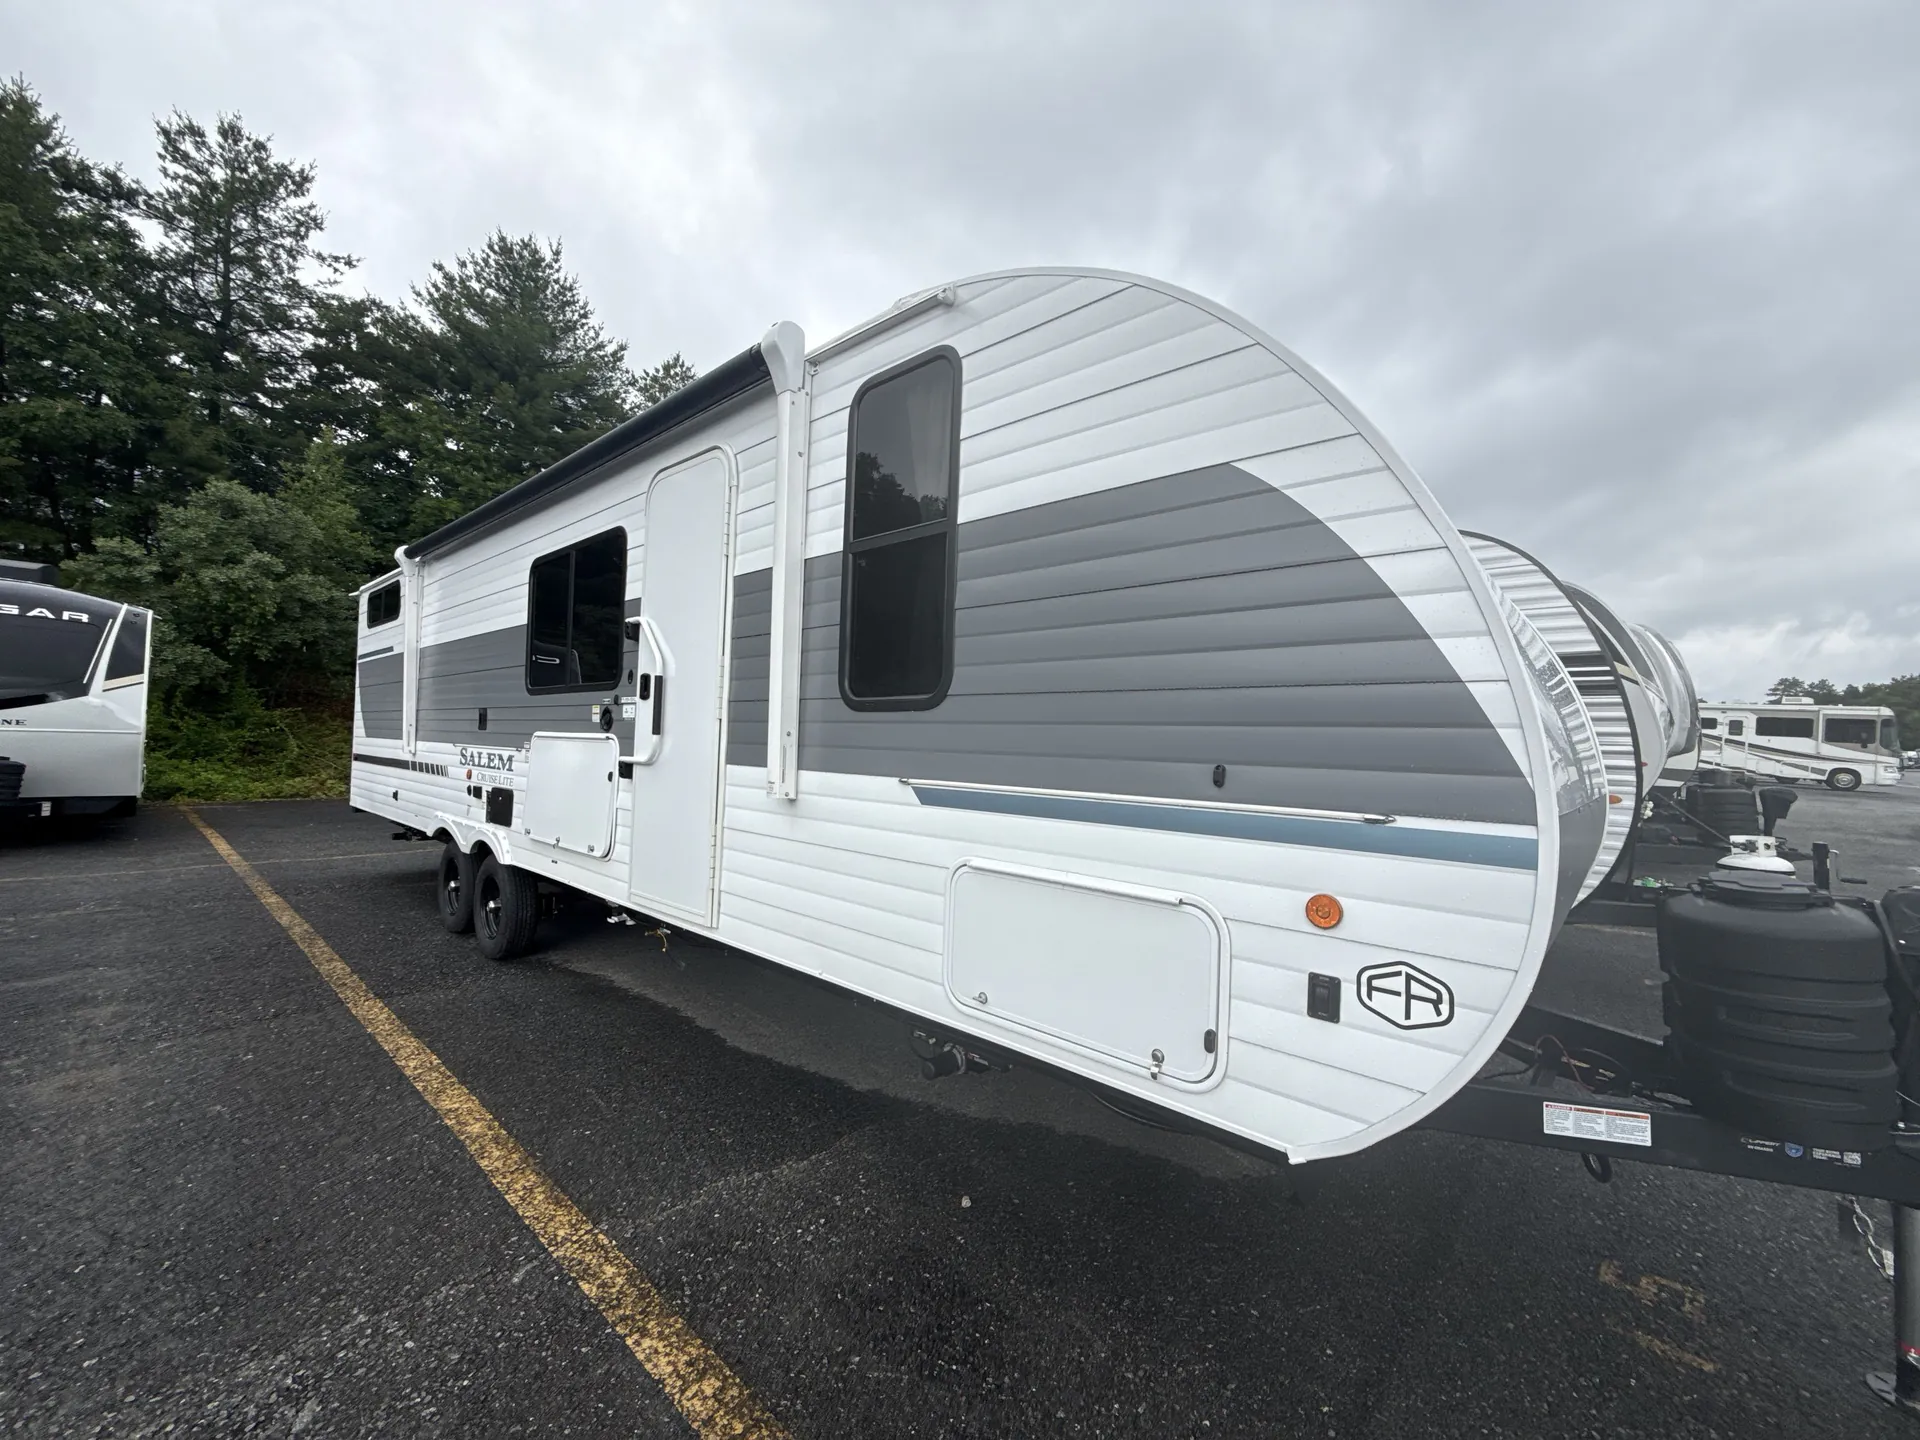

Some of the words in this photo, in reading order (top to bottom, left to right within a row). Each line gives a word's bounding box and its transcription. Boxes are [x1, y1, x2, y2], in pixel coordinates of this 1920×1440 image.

[459, 747, 515, 772] SALEM
[476, 771, 498, 785] CRUISE
[498, 774, 514, 787] LITE
[1366, 970, 1443, 1021] FR
